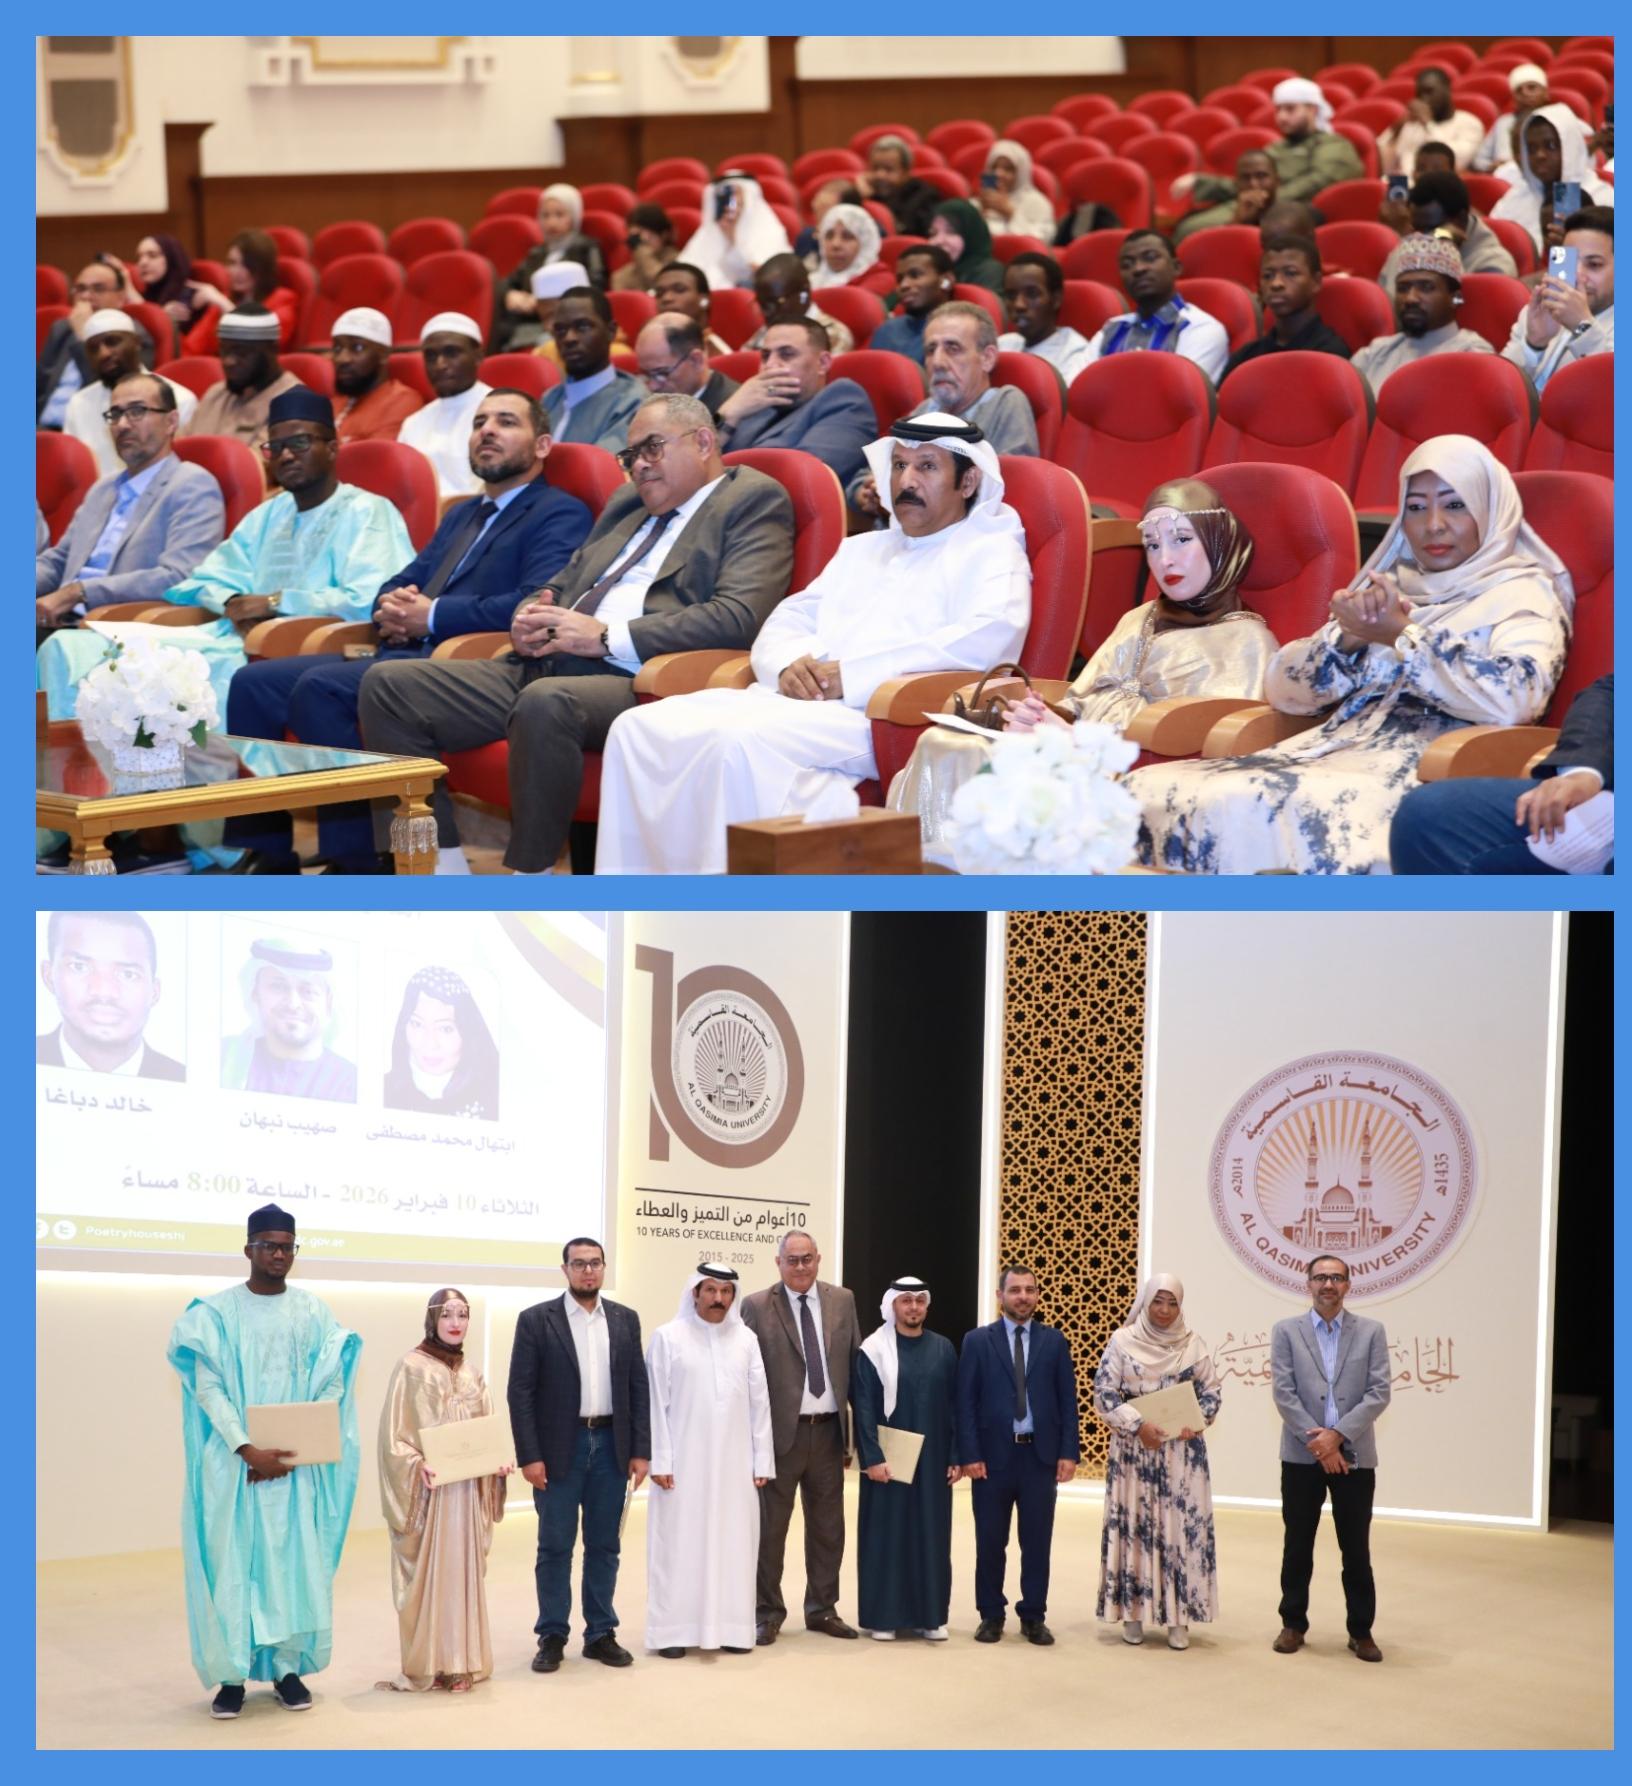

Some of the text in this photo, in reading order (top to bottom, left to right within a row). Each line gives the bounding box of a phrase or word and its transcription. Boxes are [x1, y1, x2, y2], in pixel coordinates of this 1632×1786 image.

[44, 1087, 153, 1113] خالد دباغا
[687, 1081, 772, 1129] AL QASIMIA UNIVERSITY
[1240, 1070, 1441, 1140] الجامعة القاسمية
[239, 1111, 337, 1135] صهيب نبهان
[366, 1124, 516, 1155] ابتهال محمد مصطفى
[187, 1171, 241, 1194] 8:00
[245, 1177, 318, 1200] الساعة
[340, 1184, 389, 1205] 2026
[392, 1192, 449, 1215] فبراير
[456, 1193, 477, 1211] 10
[480, 1197, 540, 1216] الثلاثاء
[635, 1199, 688, 1224] والعطاء
[692, 1205, 730, 1224] التميز
[733, 1211, 753, 1227] من
[636, 1226, 648, 1236] 10
[649, 1227, 681, 1239] YEARS
[682, 1228, 696, 1239] OF
[697, 1229, 754, 1243] EXCELLENCE
[755, 1233, 776, 1244] AND
[1239, 1210, 1437, 1277] AL QASIM NIVERSITY
[698, 1250, 723, 1263] 2015
[731, 1252, 755, 1264] 2025
